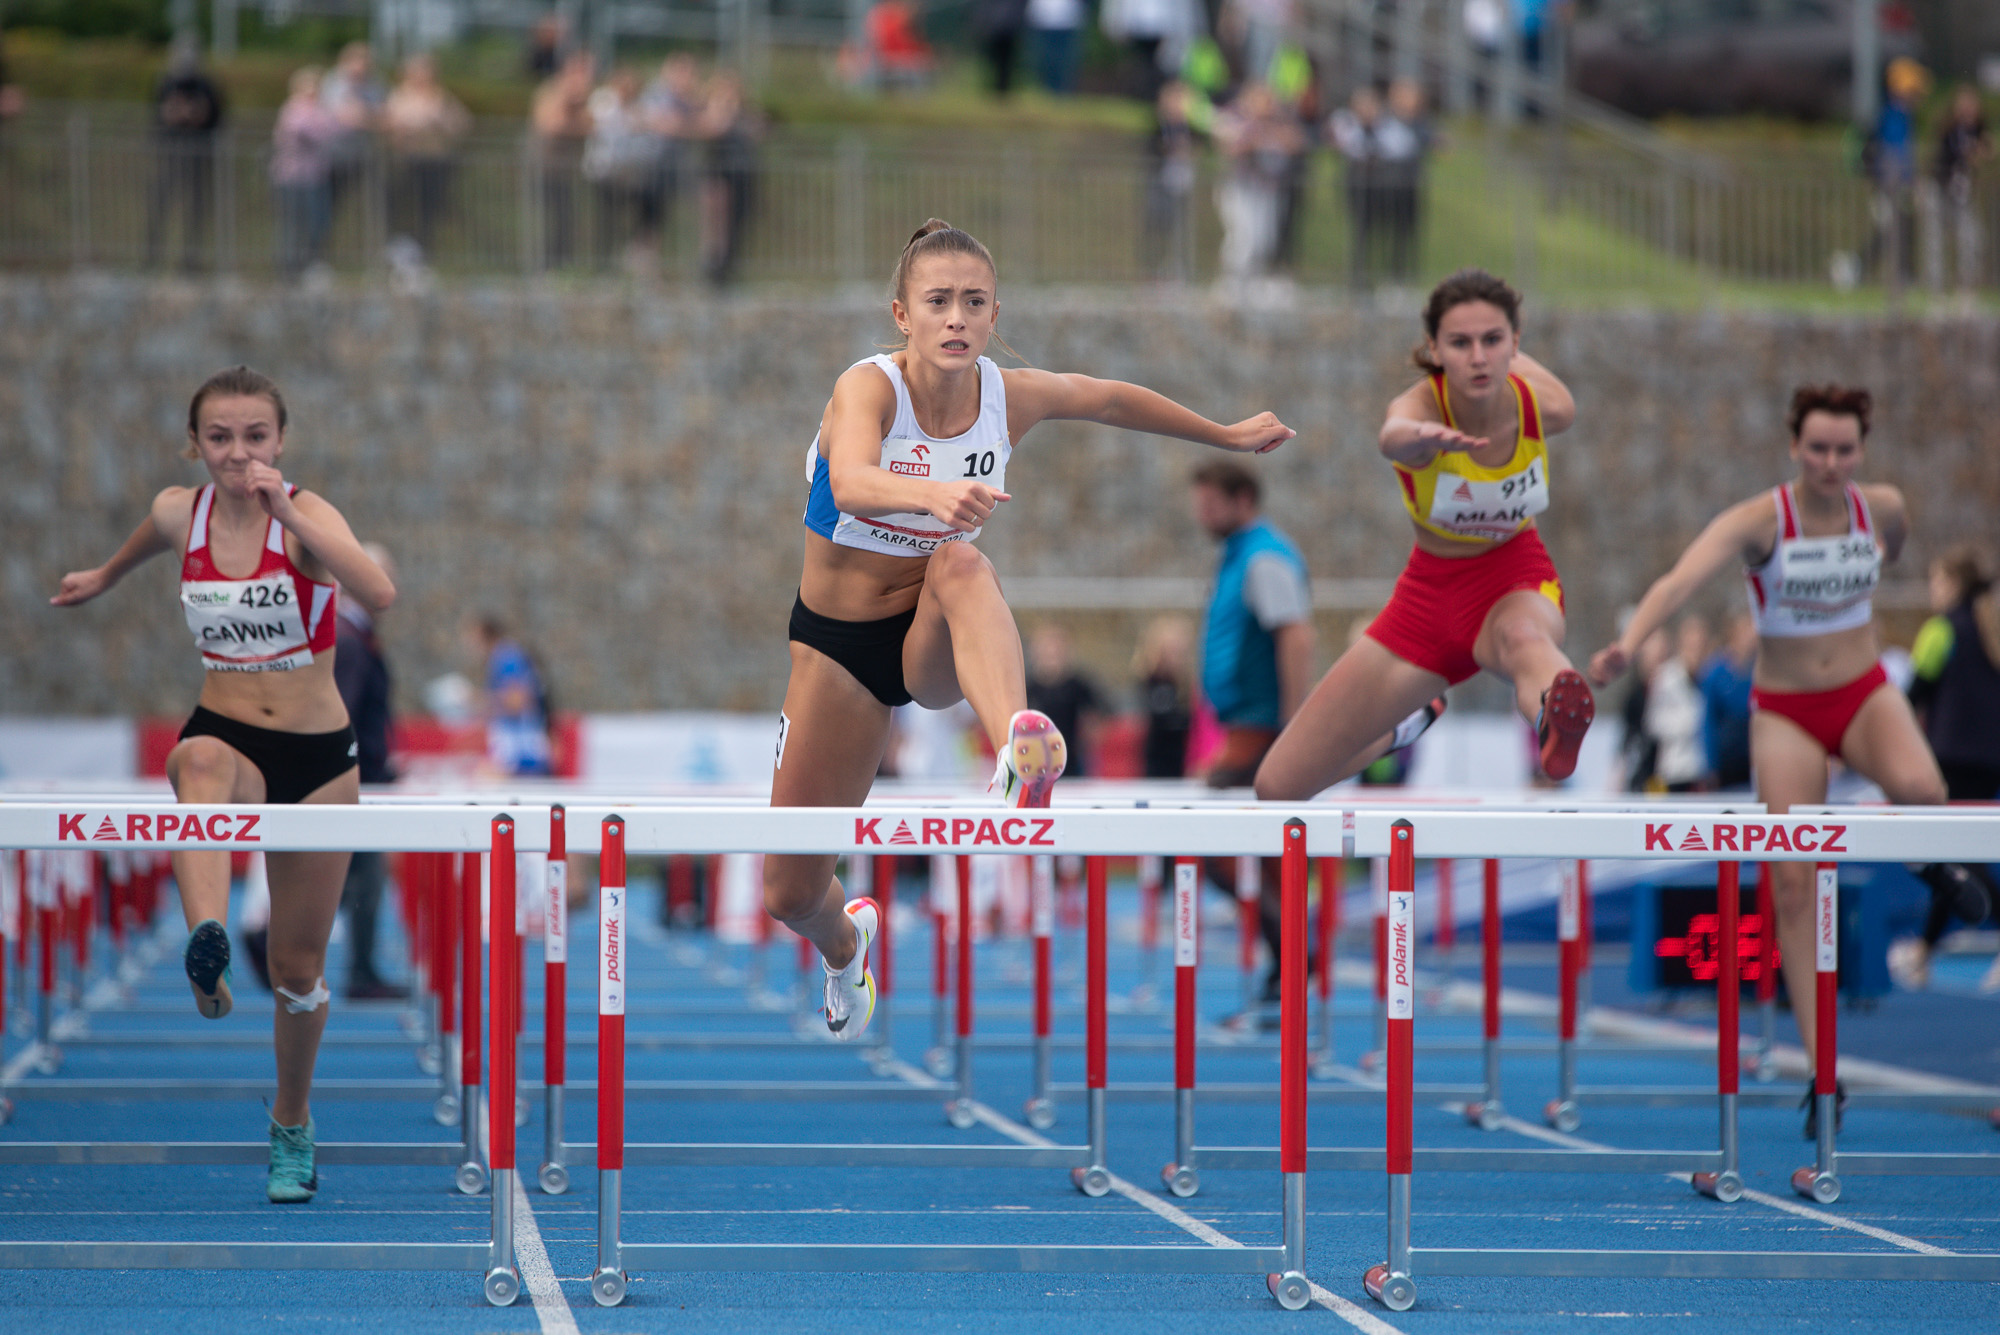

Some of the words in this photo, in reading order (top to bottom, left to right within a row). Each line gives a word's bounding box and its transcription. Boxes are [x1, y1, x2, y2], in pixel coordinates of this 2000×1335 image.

[892, 462, 929, 476] ORLEN
[963, 451, 994, 477] 10
[1501, 466, 1539, 501] 911
[1454, 503, 1528, 525] MLAK
[871, 528, 938, 551] KARPACZ
[240, 584, 288, 609] 426
[202, 620, 286, 643] GAWIN
[775, 715, 785, 760] 3
[58, 813, 261, 843] KARPACZ
[855, 817, 1055, 847] KARPACZ
[1645, 823, 1847, 853] KARPACZ
[605, 917, 621, 983] polanik
[1392, 922, 1409, 987] polanik
